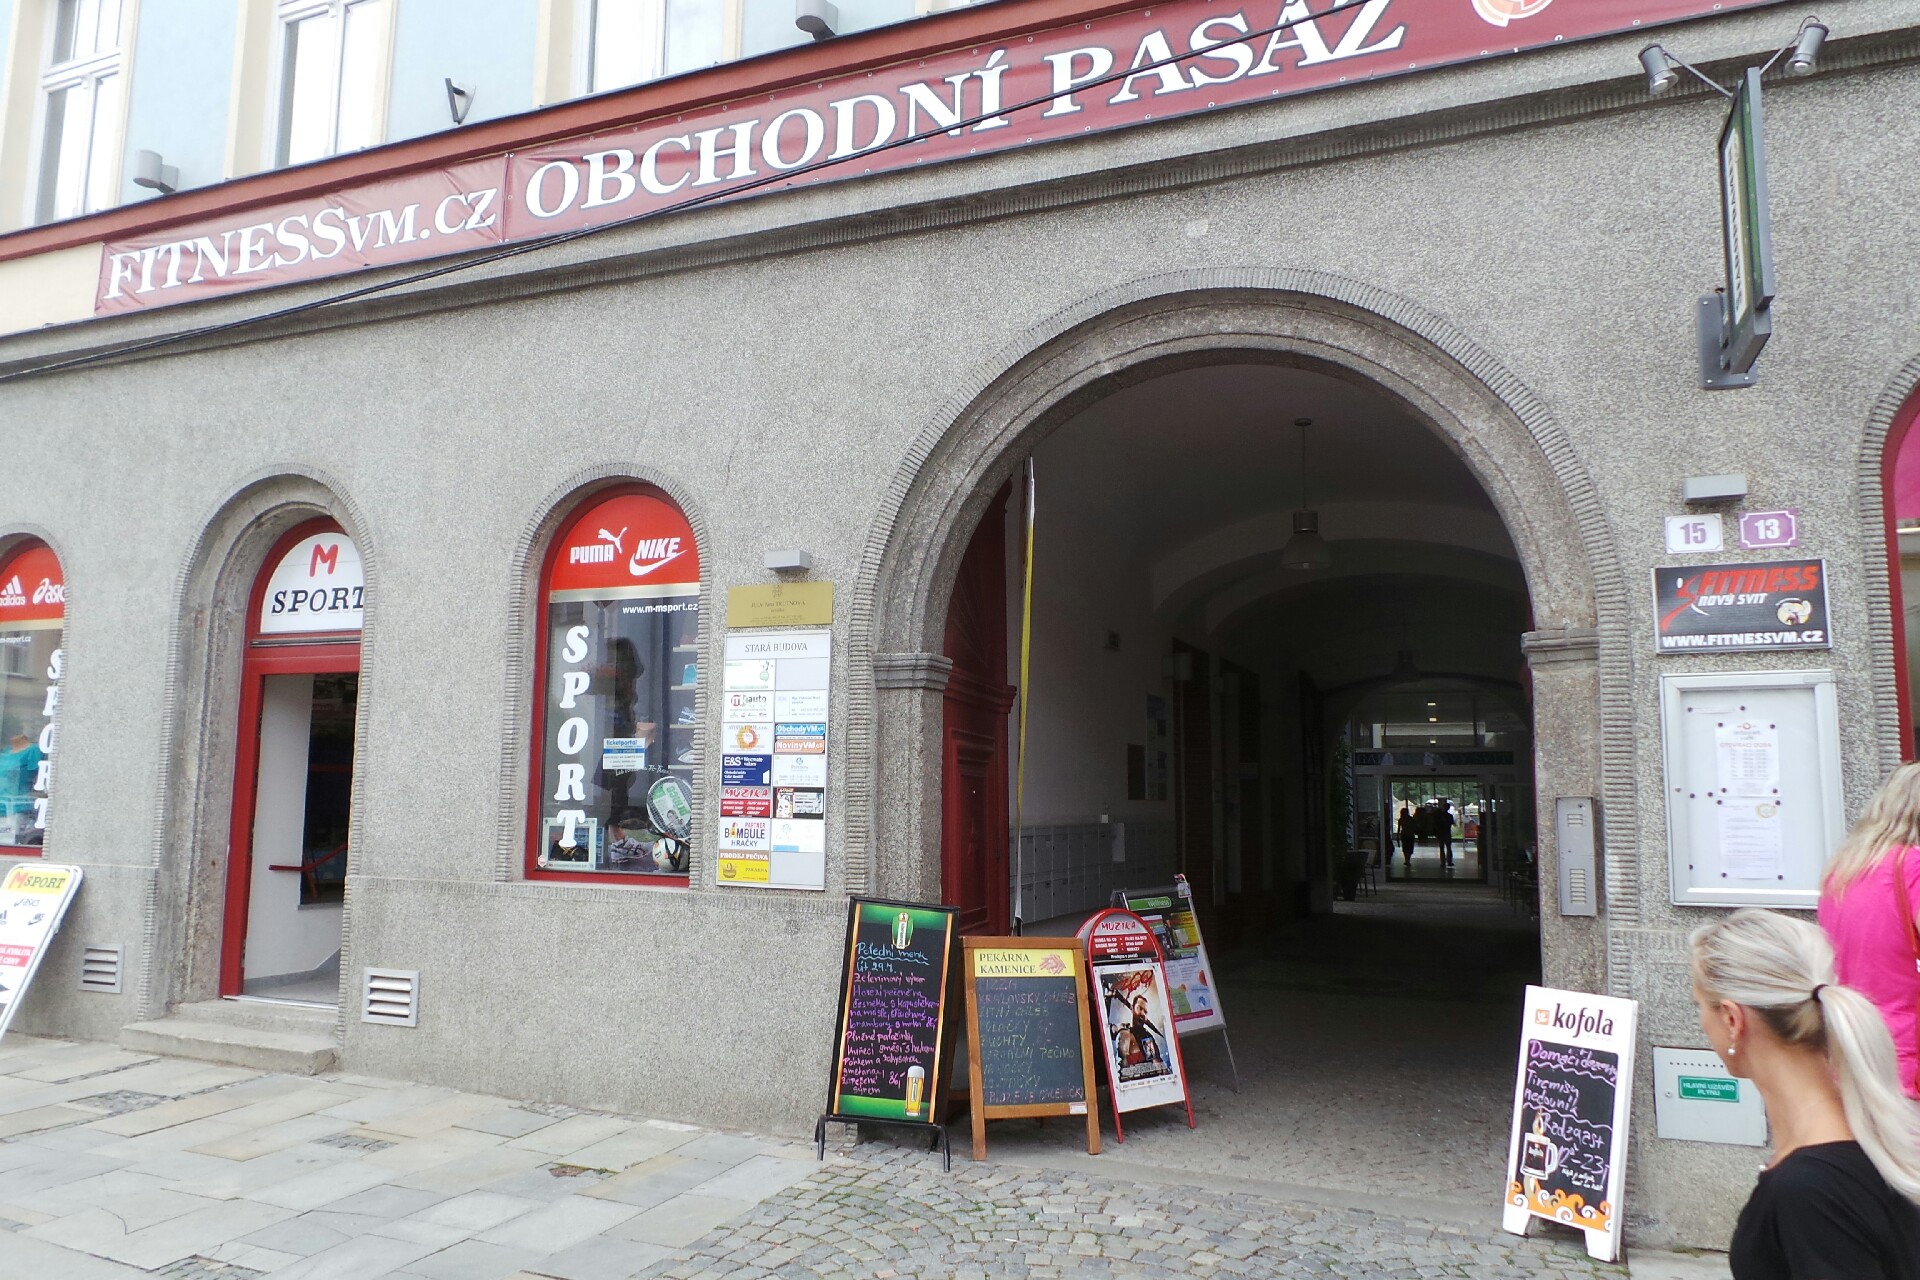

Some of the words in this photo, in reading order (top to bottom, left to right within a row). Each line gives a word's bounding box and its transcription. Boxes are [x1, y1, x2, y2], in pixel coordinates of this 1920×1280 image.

[525, 48, 1010, 218] OBCHODNÍ
[1679, 522, 1707, 545] 15
[1754, 518, 1781, 540] 13
[569, 544, 614, 564] PUMA
[635, 537, 681, 560] NIKE
[309, 543, 339, 577] M
[1697, 565, 1820, 596] FITNESS
[271, 586, 364, 614] SPORT
[1737, 592, 1768, 605] SVIT
[622, 602, 699, 614] www.m-msport.cz
[1662, 630, 1824, 648] WWW.FITNESSVM.CZ
[745, 642, 771, 653] STARÁ
[773, 642, 808, 652] BUDOVA
[557, 625, 591, 847] SPORT
[606, 739, 638, 747] ticketportal
[724, 757, 742, 767] E&S
[724, 788, 769, 798] MUZIKA
[731, 839, 758, 847] HRAČKY
[23, 876, 66, 889] SPORT
[1101, 920, 1137, 930] MUZIKA
[855, 942, 894, 957] Polední
[979, 952, 1031, 962] PEKÁRNA
[980, 965, 1036, 974] KAMENICE
[1552, 1003, 1614, 1038] kofola
[1039, 1046, 1075, 1060] PEČIVO
